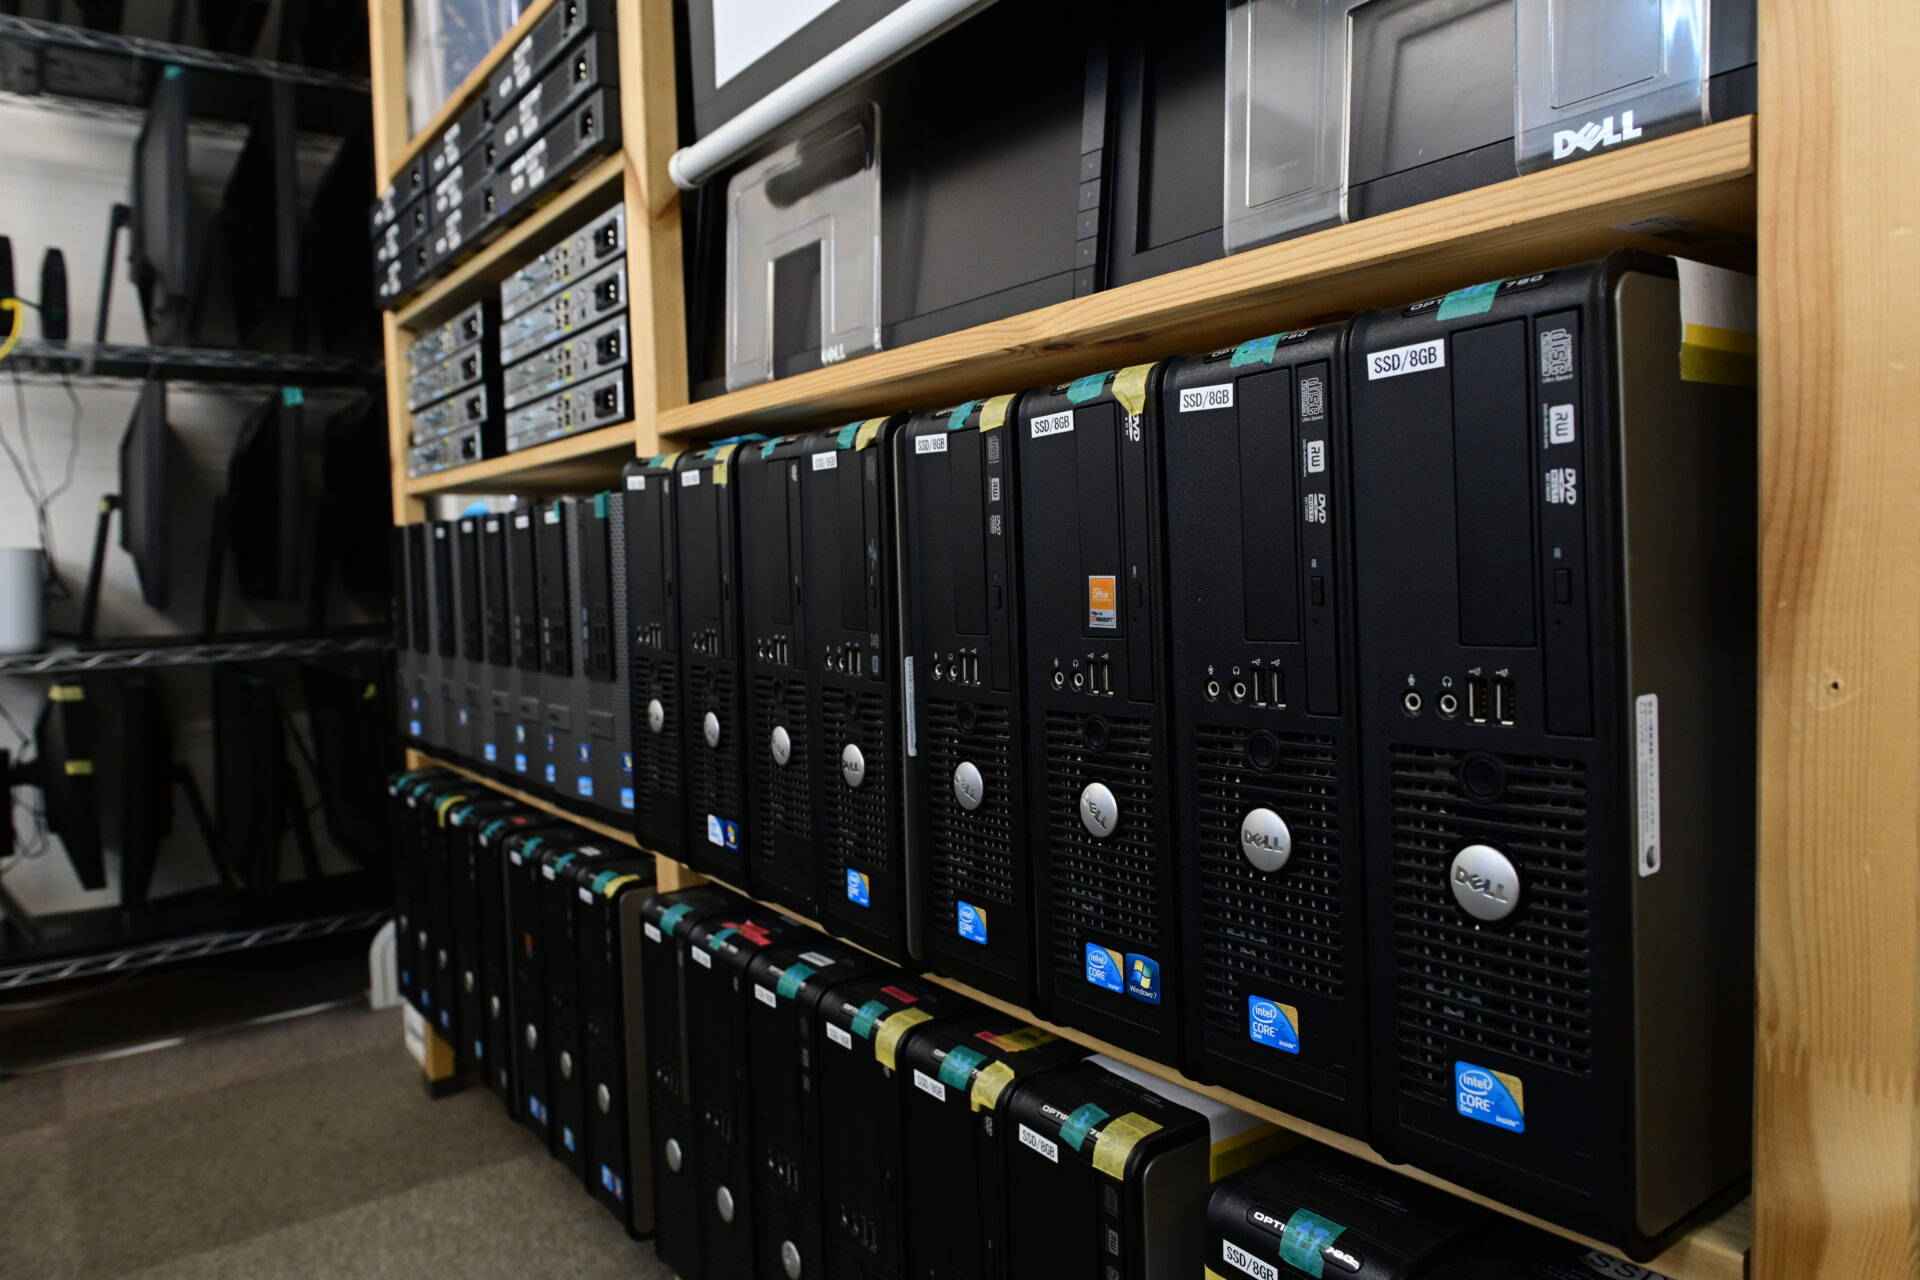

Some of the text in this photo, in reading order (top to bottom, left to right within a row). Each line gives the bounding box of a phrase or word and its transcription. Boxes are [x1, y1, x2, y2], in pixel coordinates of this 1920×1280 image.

[1553, 109, 1642, 160] DELL
[1374, 346, 1438, 374] SSD/8GB
[1183, 389, 1230, 409] SSD/8GB
[1034, 417, 1070, 434] SSD/8GB
[1554, 411, 1569, 437] RW
[917, 438, 945, 451] SSD/8GB
[1311, 446, 1320, 467] RW
[1565, 468, 1577, 505] DVD
[1318, 492, 1327, 524] DVD
[1244, 829, 1284, 853] DELL
[1455, 865, 1508, 904] DELL
[1090, 954, 1105, 964] intel
[1088, 967, 1106, 981] CORE
[1129, 984, 1153, 999] Windows
[1255, 1004, 1273, 1019] intel
[1252, 1021, 1276, 1038] CORE
[1463, 1072, 1488, 1090] intel
[1459, 1092, 1491, 1113] CORE
[1495, 1114, 1516, 1128] inside
[1022, 1129, 1055, 1159] SSD/8GB
[1226, 1245, 1274, 1280] SSD/8GB
